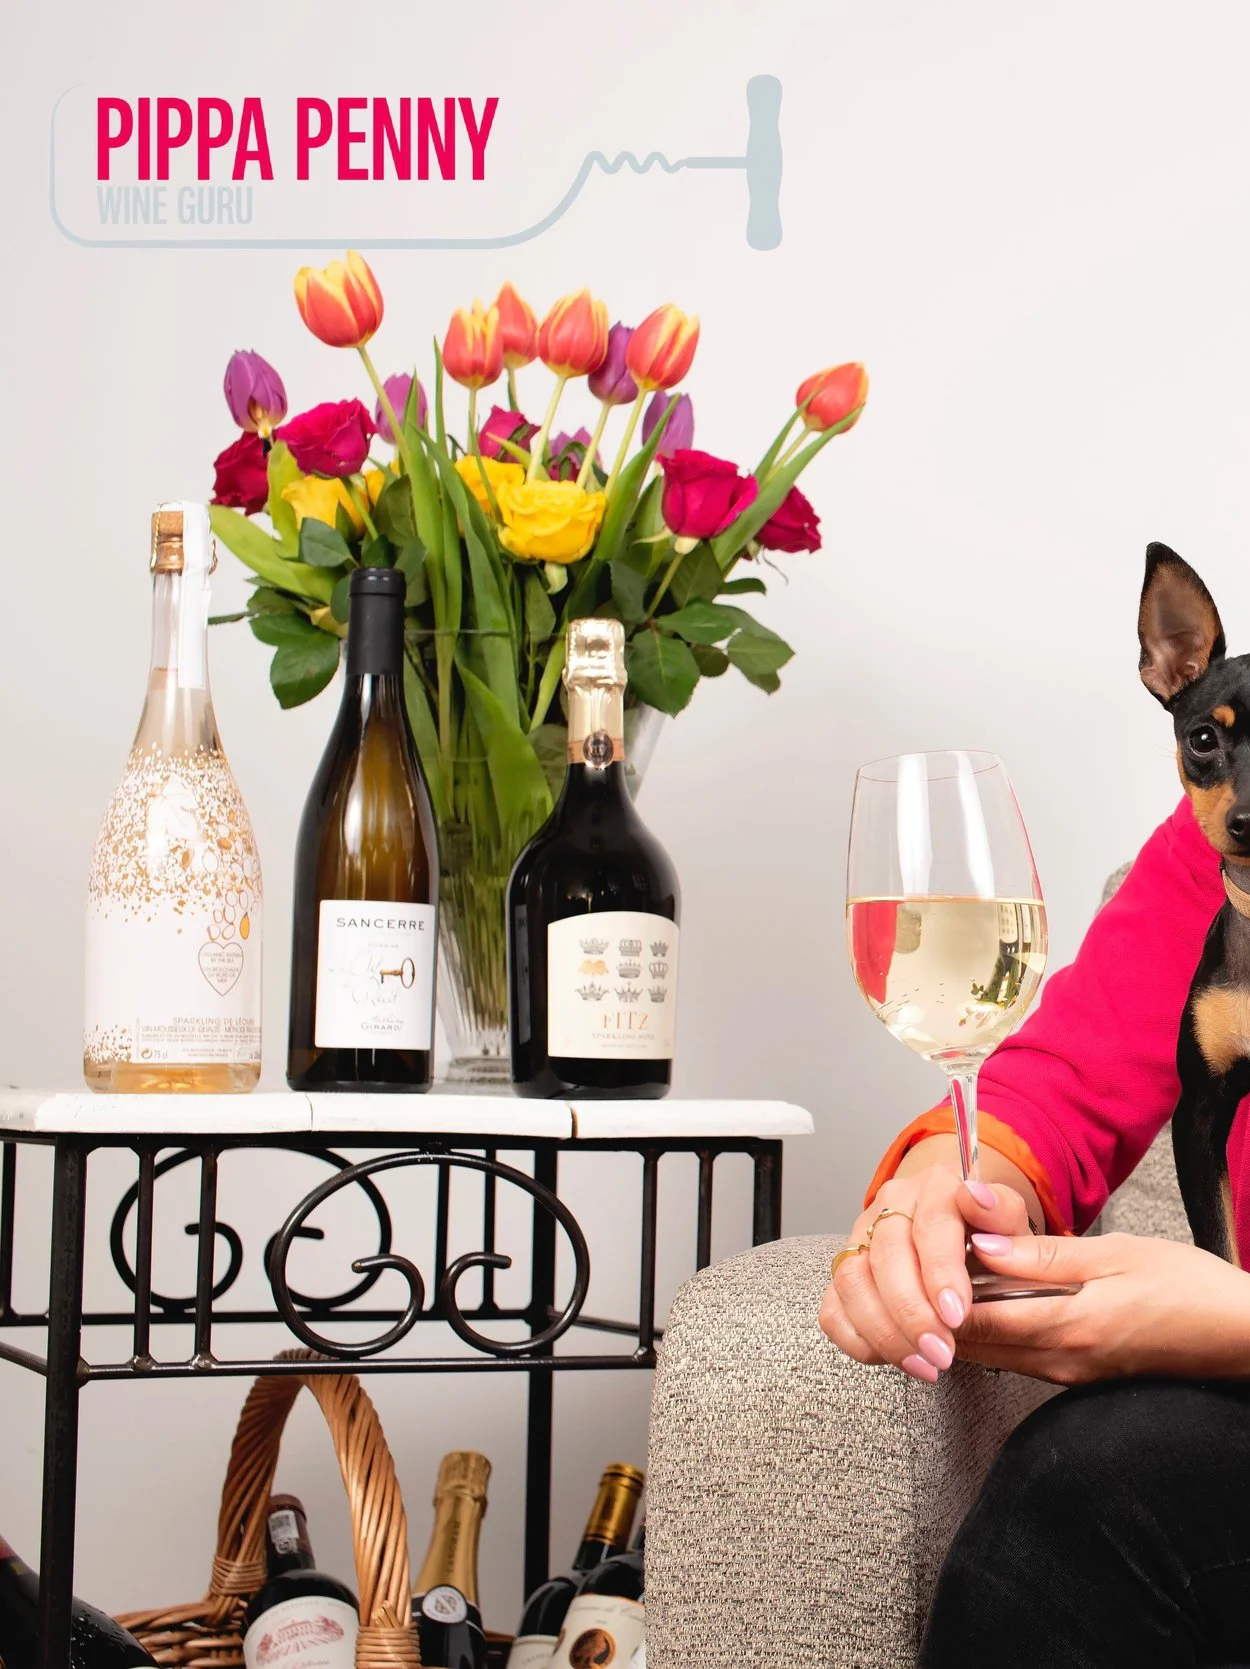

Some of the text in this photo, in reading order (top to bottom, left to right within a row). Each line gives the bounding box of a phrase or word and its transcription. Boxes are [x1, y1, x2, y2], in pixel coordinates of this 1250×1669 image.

[336, 917, 425, 931] SANCERRE
[172, 1017, 221, 1026] SPARKLING
[603, 1010, 650, 1030] FITZ
